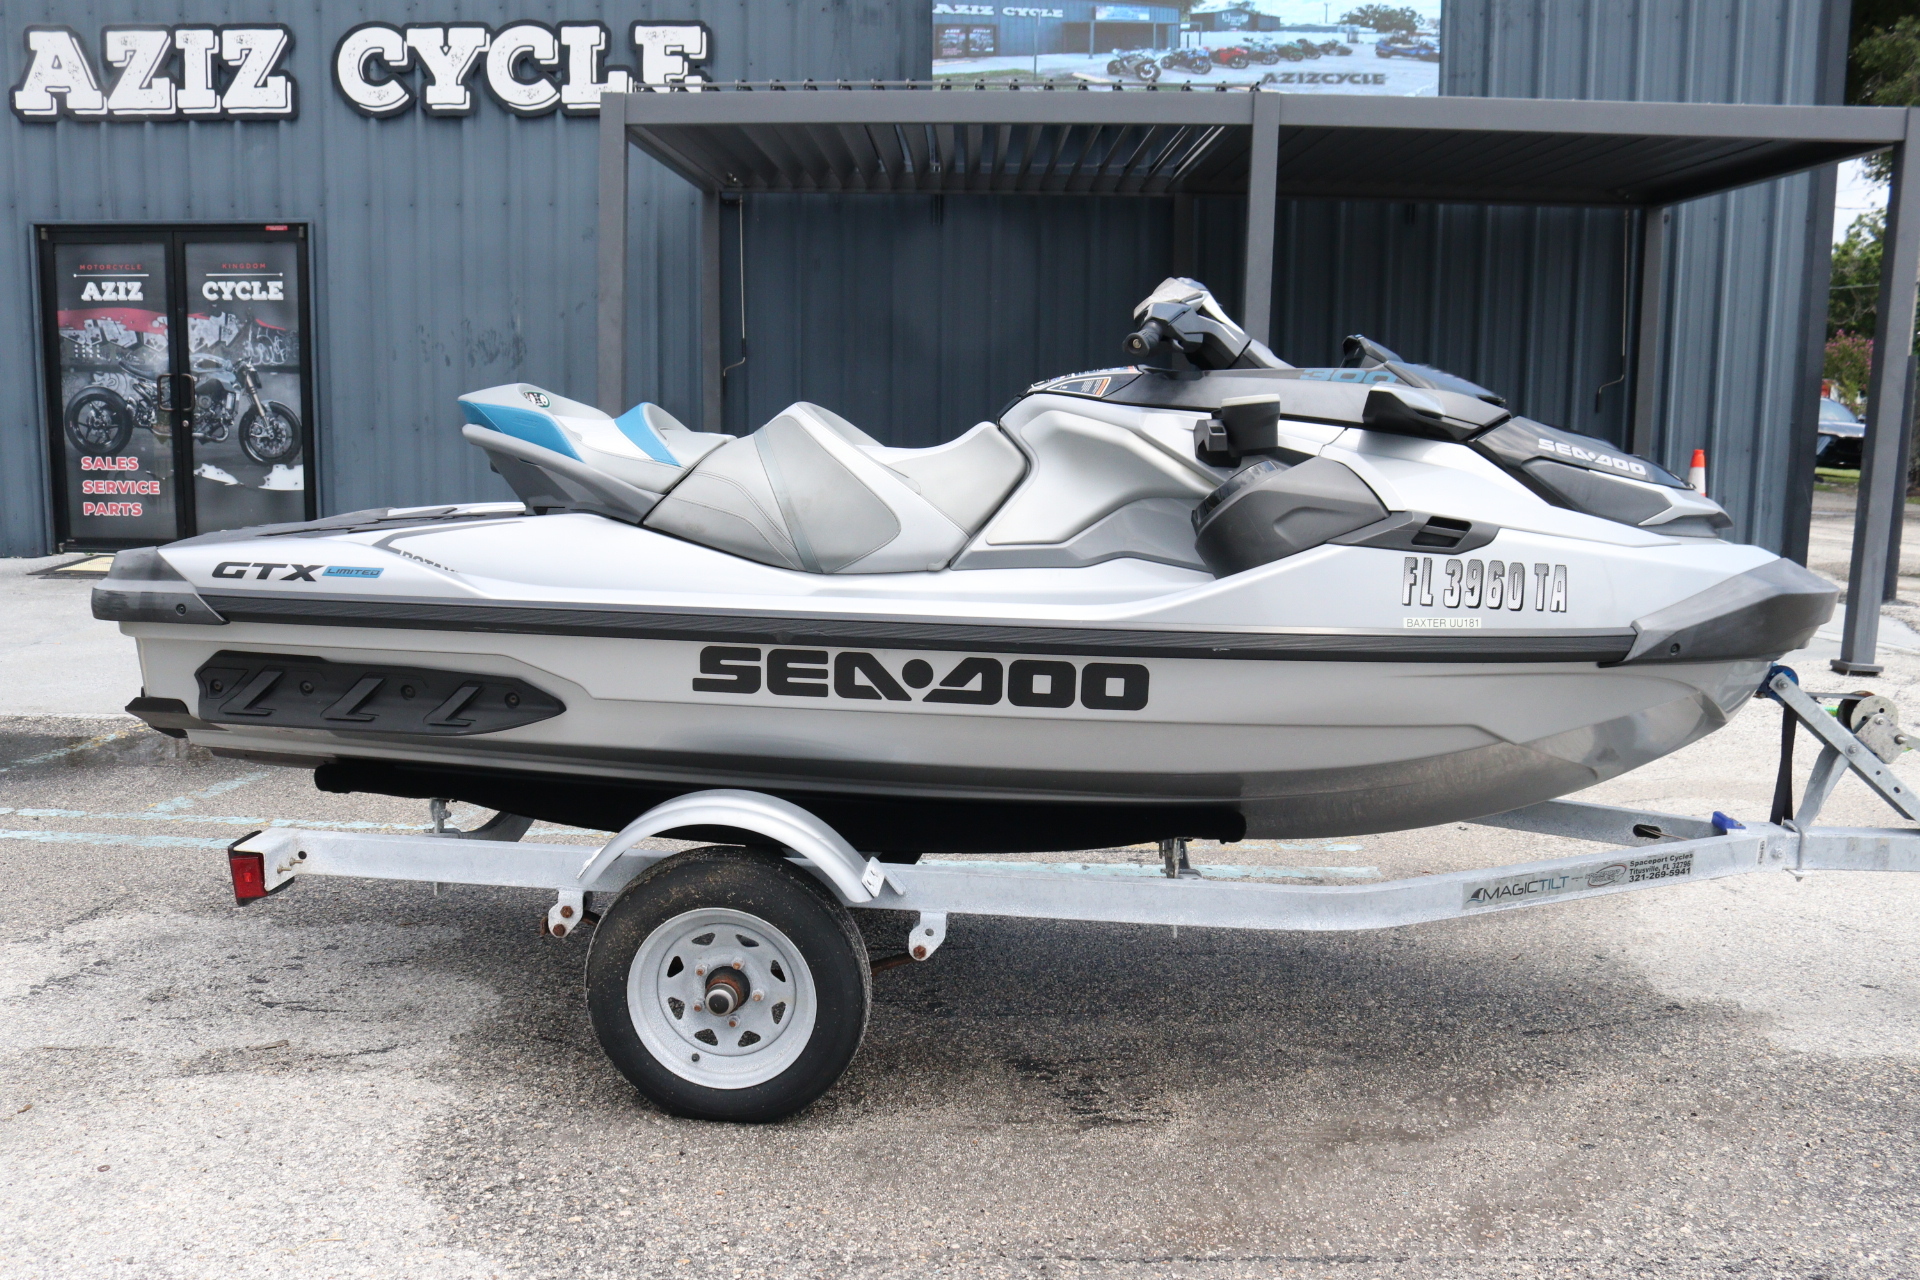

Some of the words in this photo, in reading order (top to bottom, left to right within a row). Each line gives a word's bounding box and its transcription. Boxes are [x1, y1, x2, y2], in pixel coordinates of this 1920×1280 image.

[932, 3, 995, 15] AZIZ
[1002, 7, 1063, 18] CYCLE
[14, 28, 292, 116] AZIZ
[336, 24, 708, 113] CYCLE
[1261, 72, 1387, 84] AZIZCYCLE
[79, 263, 143, 271] MOTORCYCLE
[81, 281, 143, 301] AZIZ
[202, 280, 284, 301] CYCLE
[1300, 368, 1398, 384] 300
[81, 456, 139, 471] SALES
[82, 480, 160, 495] SERVICE
[83, 501, 143, 516] PARTS
[211, 561, 325, 583] GTX
[326, 568, 382, 577] LIMITED
[1402, 556, 1433, 606] FL
[1443, 558, 1525, 611] 3960
[1534, 562, 1567, 613] TA
[1406, 618, 1447, 628] BAXTER
[1449, 618, 1480, 628] UU181
[1629, 866, 1661, 876] Titusville,
[1662, 863, 1670, 871] FL
[1671, 860, 1691, 869] 32796
[1630, 856, 1668, 868] Spaceport
[1669, 853, 1693, 863] Cycles
[1628, 867, 1691, 882] 321-269-5941
[1482, 875, 1570, 900] MAGICTILT
